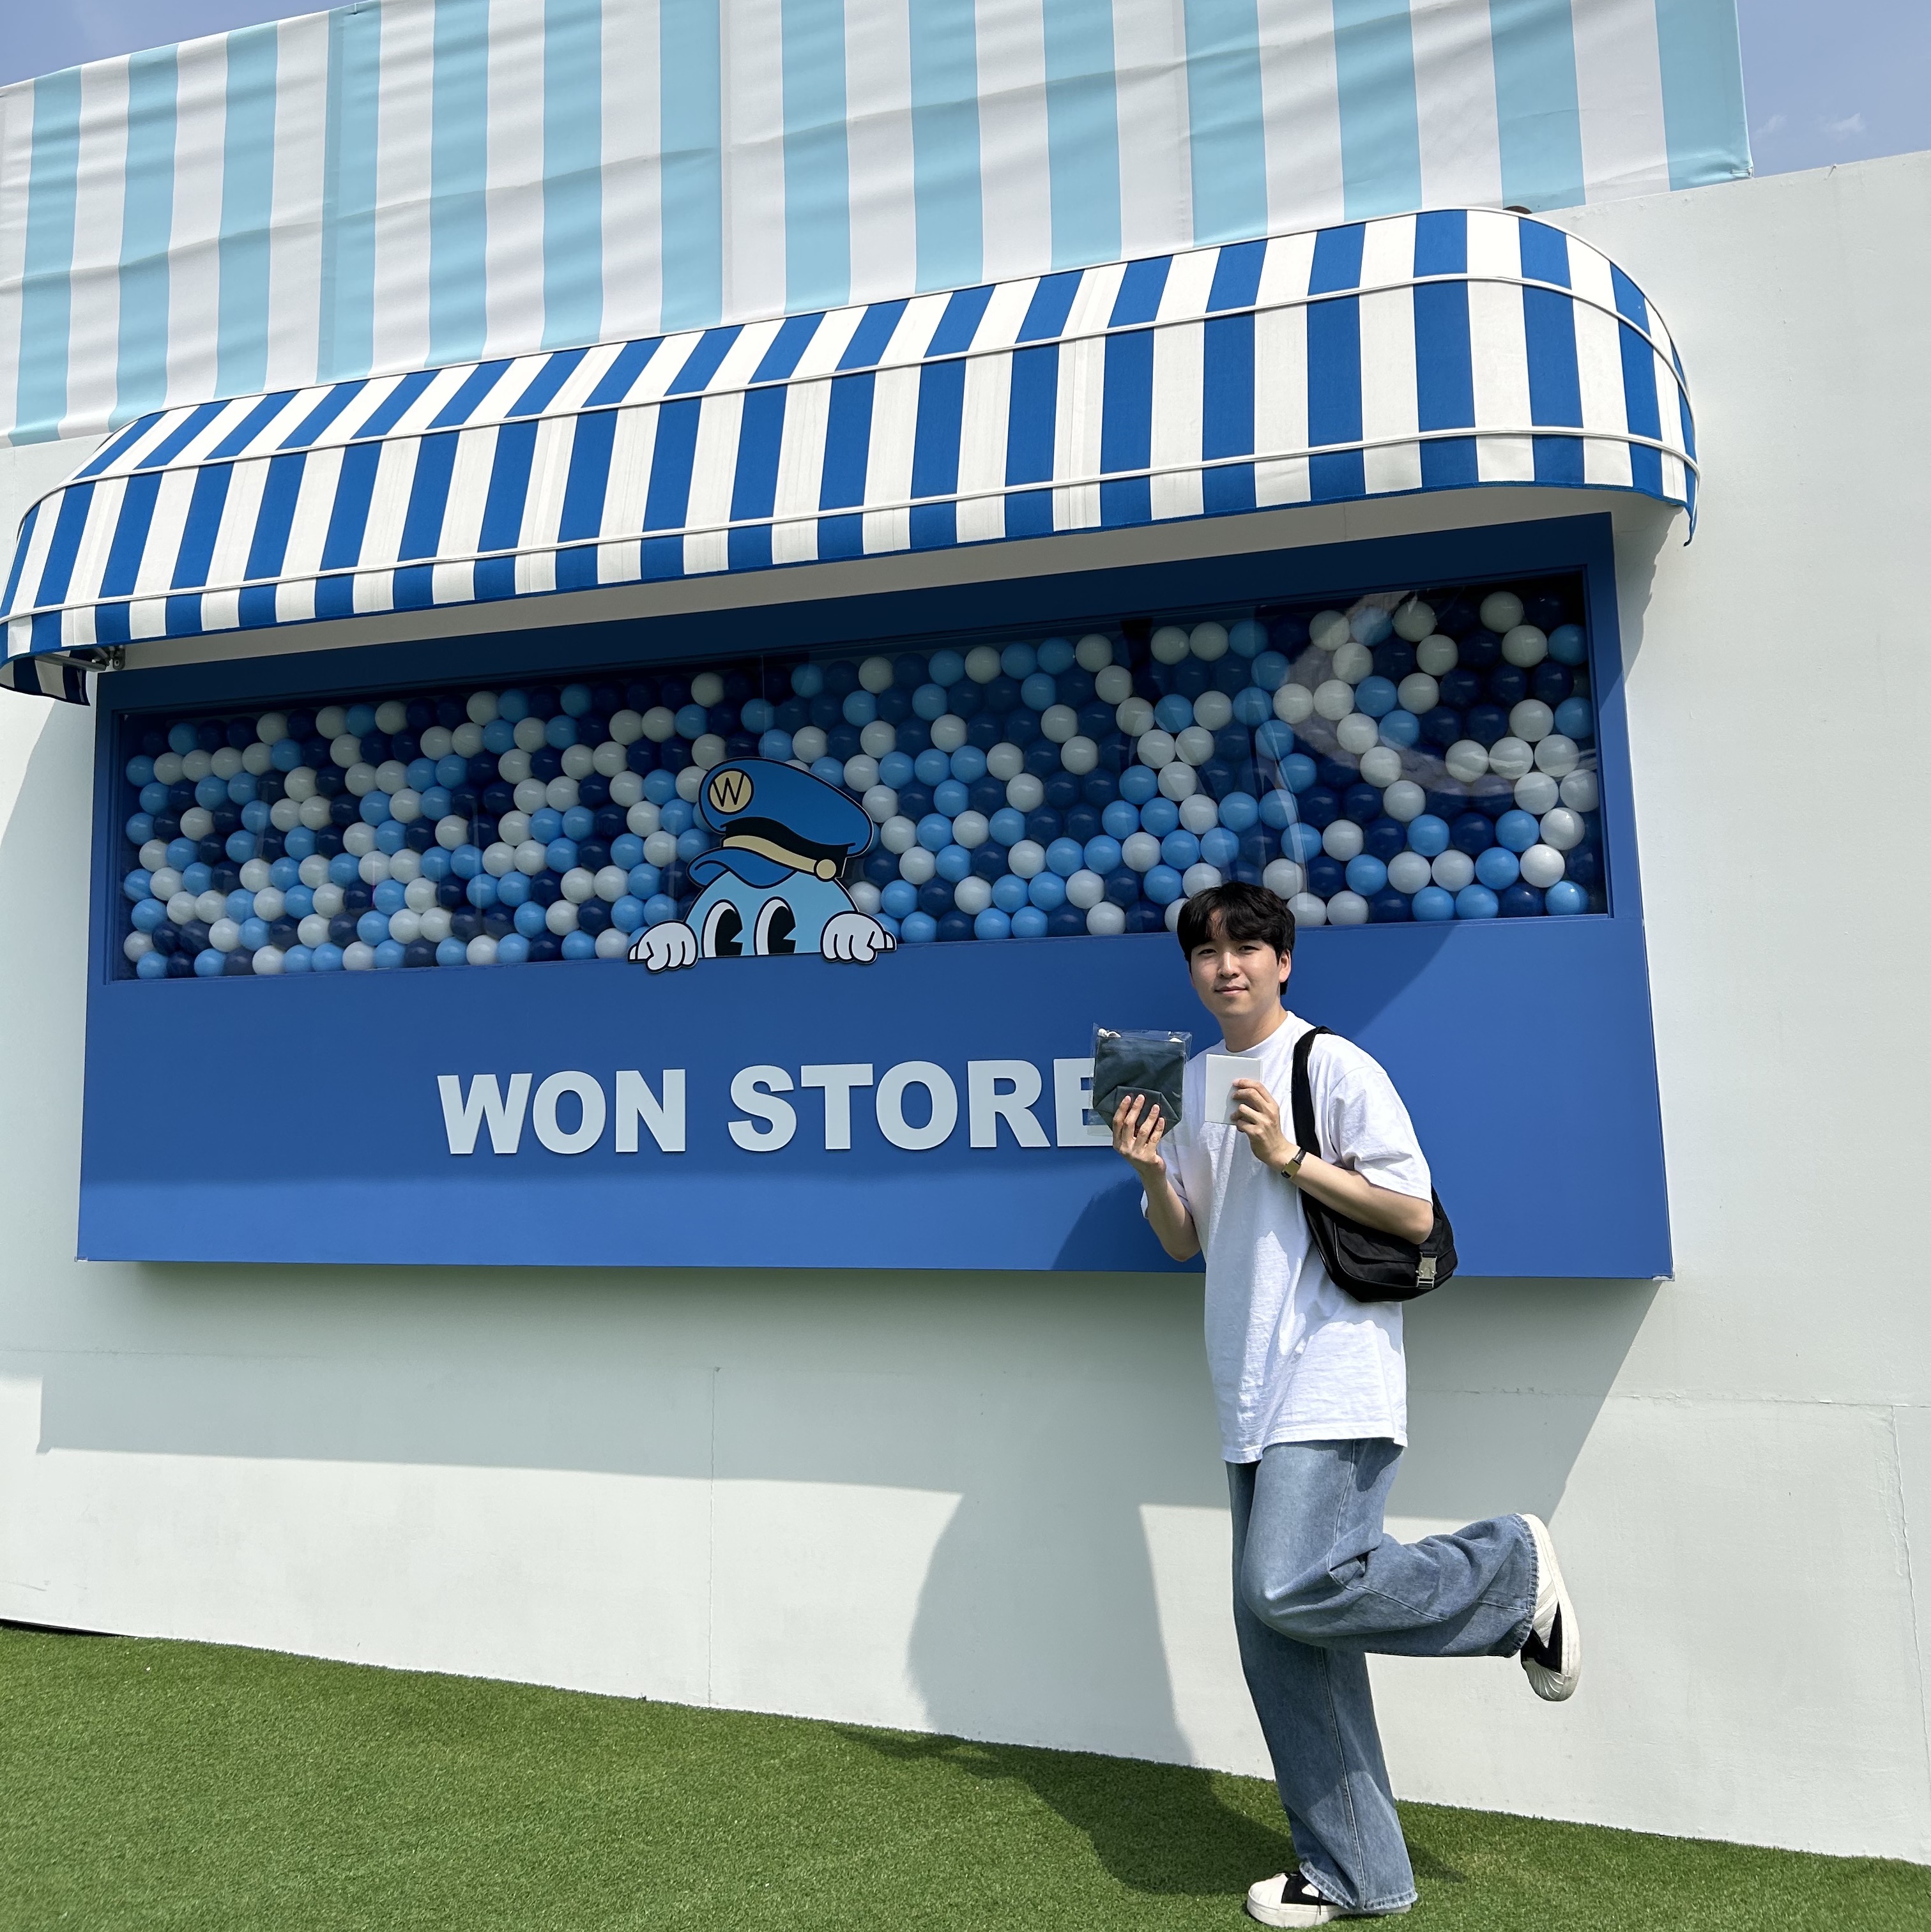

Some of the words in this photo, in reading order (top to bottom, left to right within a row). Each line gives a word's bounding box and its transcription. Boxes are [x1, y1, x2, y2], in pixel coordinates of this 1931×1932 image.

[712, 773, 745, 807] W
[437, 1069, 685, 1154] WON
[728, 1058, 1113, 1152] STORE
